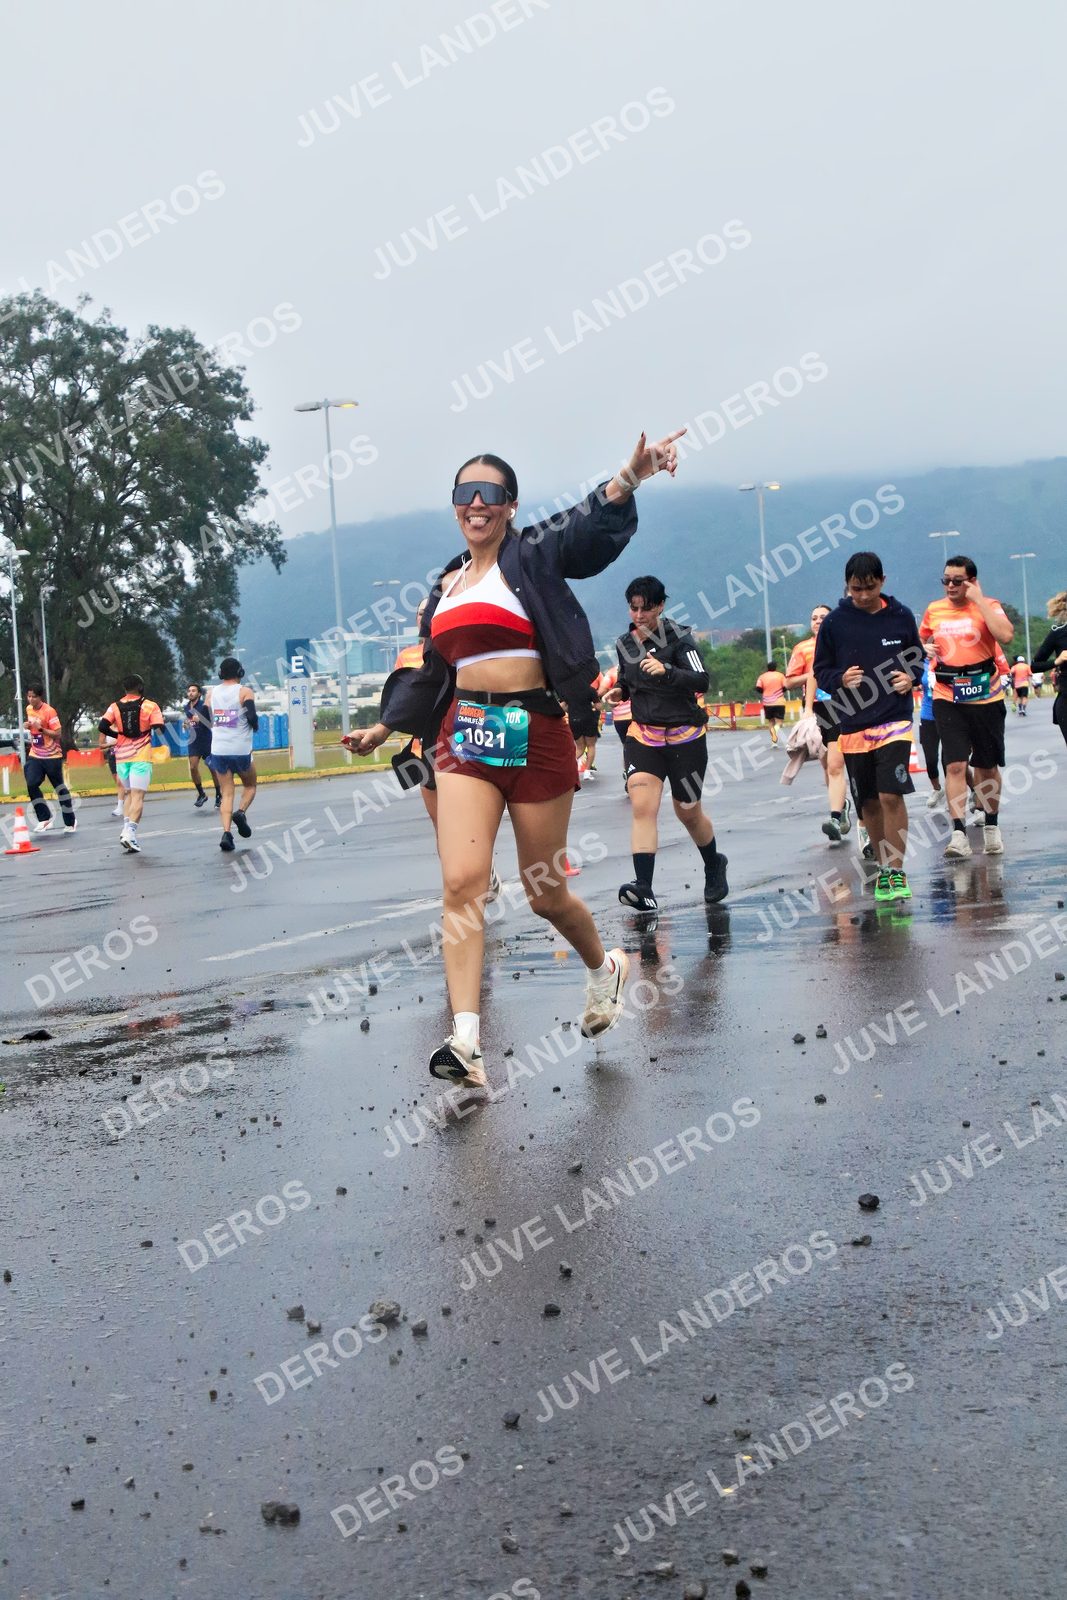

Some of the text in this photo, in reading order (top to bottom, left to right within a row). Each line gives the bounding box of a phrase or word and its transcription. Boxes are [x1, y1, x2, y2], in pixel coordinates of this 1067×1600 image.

[291, 655, 304, 673] E
[960, 685, 983, 696] 1003
[505, 711, 522, 724] 10K
[465, 727, 505, 749] 1021
